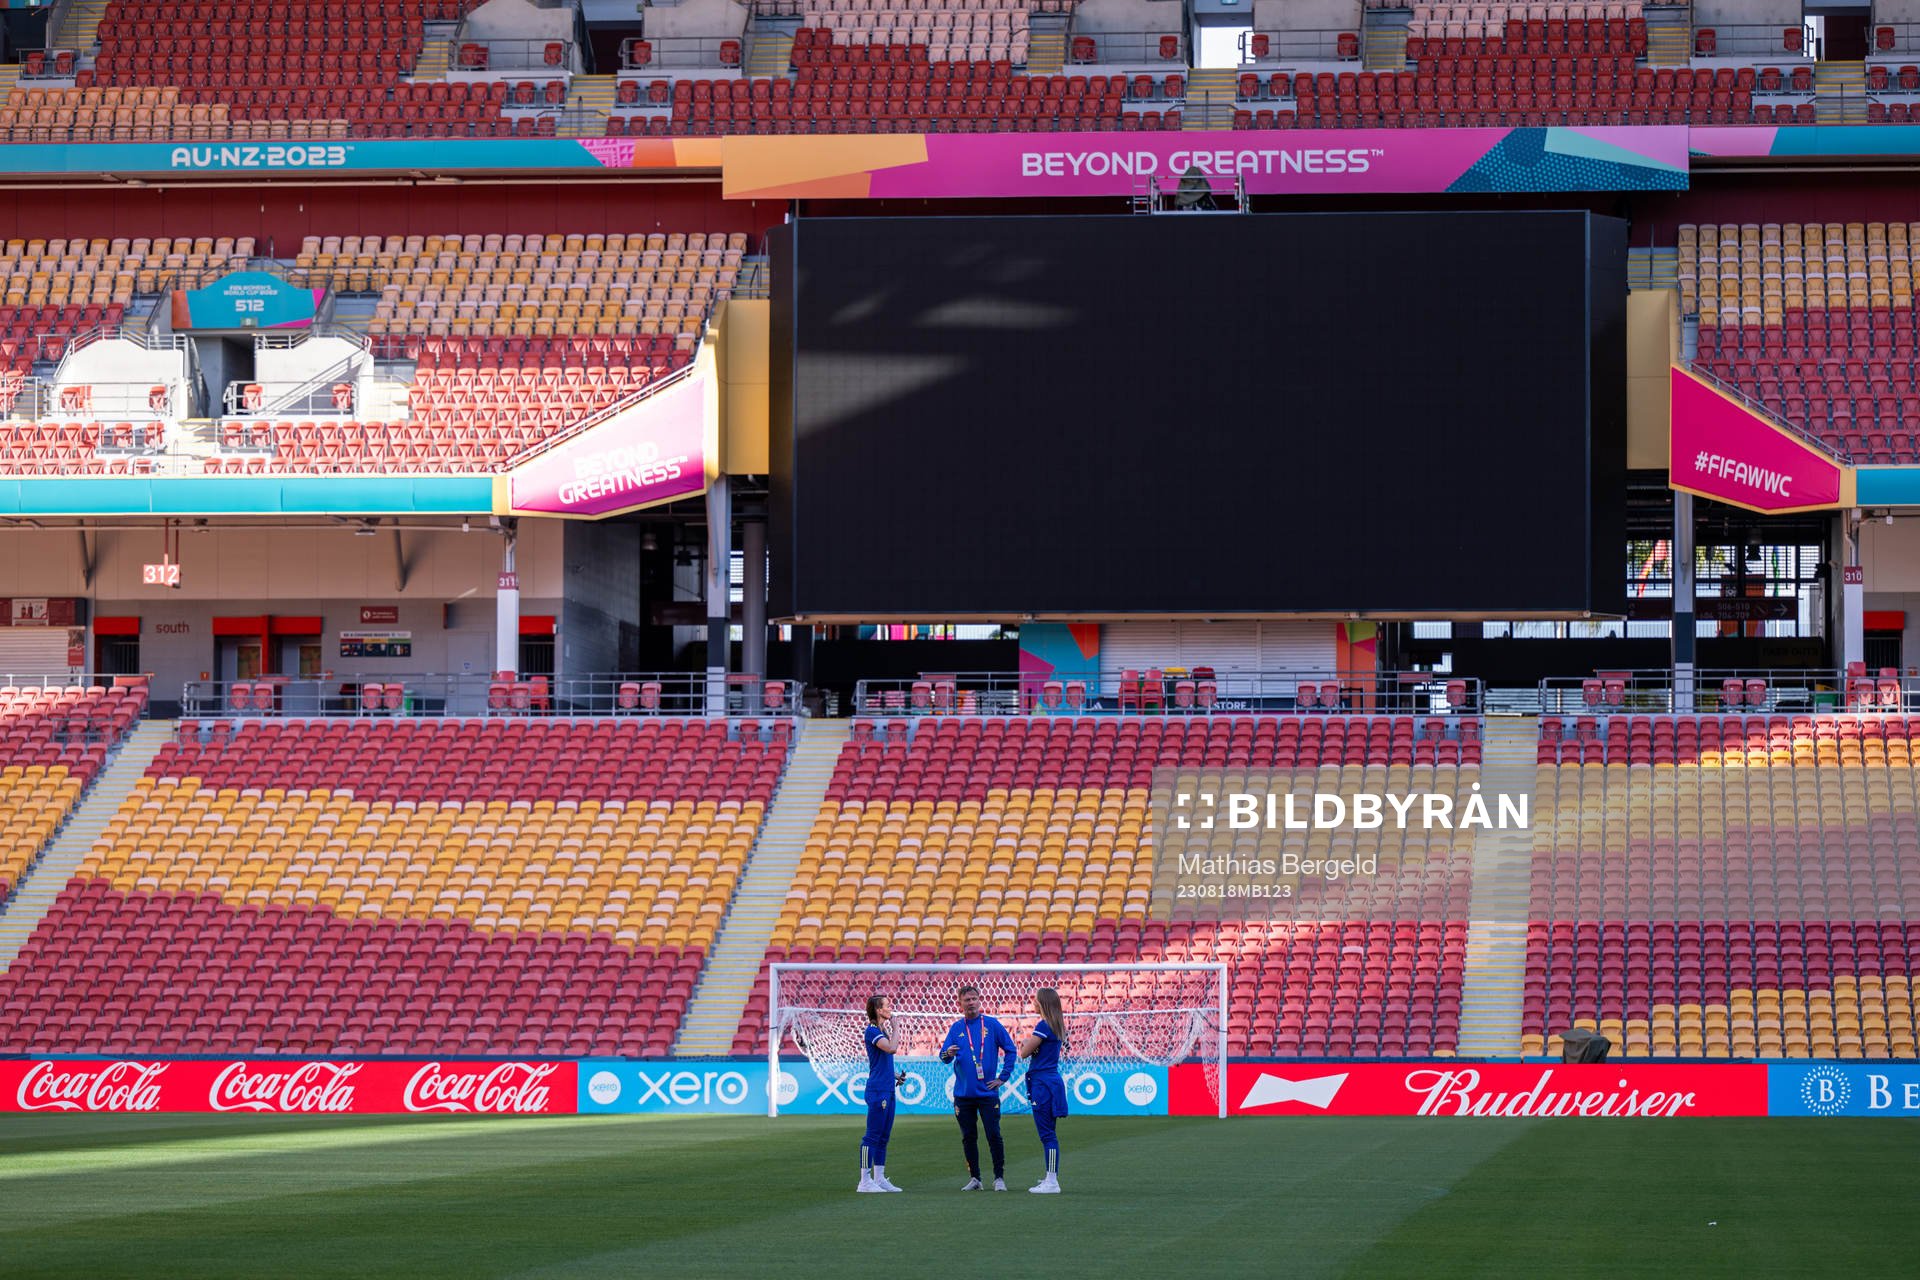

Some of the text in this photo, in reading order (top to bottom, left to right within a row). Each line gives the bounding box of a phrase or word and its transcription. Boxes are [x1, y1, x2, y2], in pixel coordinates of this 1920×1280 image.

[1022, 151, 1158, 176] BEYOND
[235, 299, 265, 312] 512
[574, 442, 659, 479] BEYOND
[1694, 451, 1793, 497] #FIFAWWC
[145, 565, 178, 584] 312
[499, 576, 515, 587] 311
[1845, 571, 1862, 582] 310
[155, 621, 190, 634] south
[1214, 701, 1248, 710] STORE
[17, 1061, 171, 1111] Coca-Cola
[209, 1061, 364, 1112] Coca-Cola
[403, 1062, 559, 1113] Coca-Cola
[591, 1083, 618, 1093] xero
[638, 1071, 749, 1105] xero
[1128, 1084, 1154, 1094] xero
[1405, 1069, 1696, 1117] Budweiser
